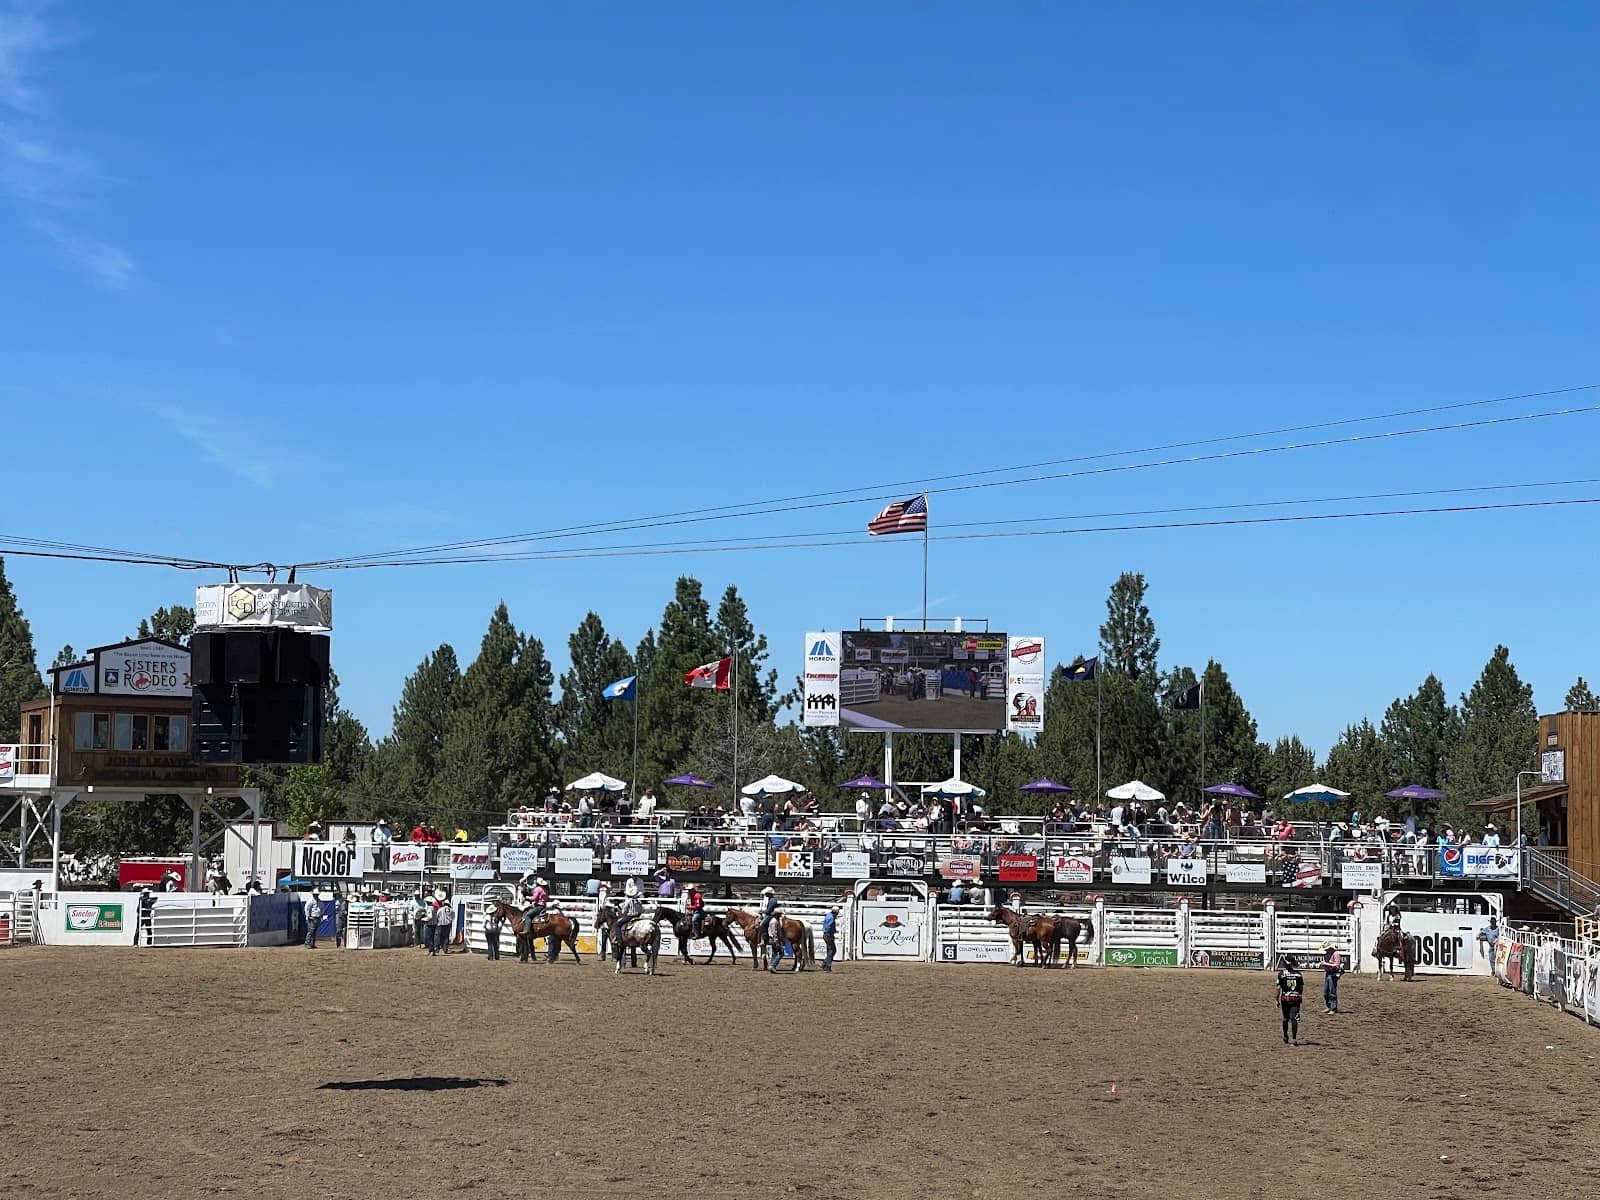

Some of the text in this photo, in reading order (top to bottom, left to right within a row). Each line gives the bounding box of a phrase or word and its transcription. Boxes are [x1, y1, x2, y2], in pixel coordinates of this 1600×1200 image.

[124, 671, 177, 691] RODEO
[302, 846, 356, 877] Nosler
[778, 853, 811, 870] H&E
[1169, 873, 1206, 884] Wilco
[71, 909, 97, 918] Sinclair
[863, 929, 918, 946] Crown Royal
[1111, 951, 1134, 963] Ray's
[1412, 933, 1463, 967] osler
[1143, 956, 1169, 965] LOCAL
